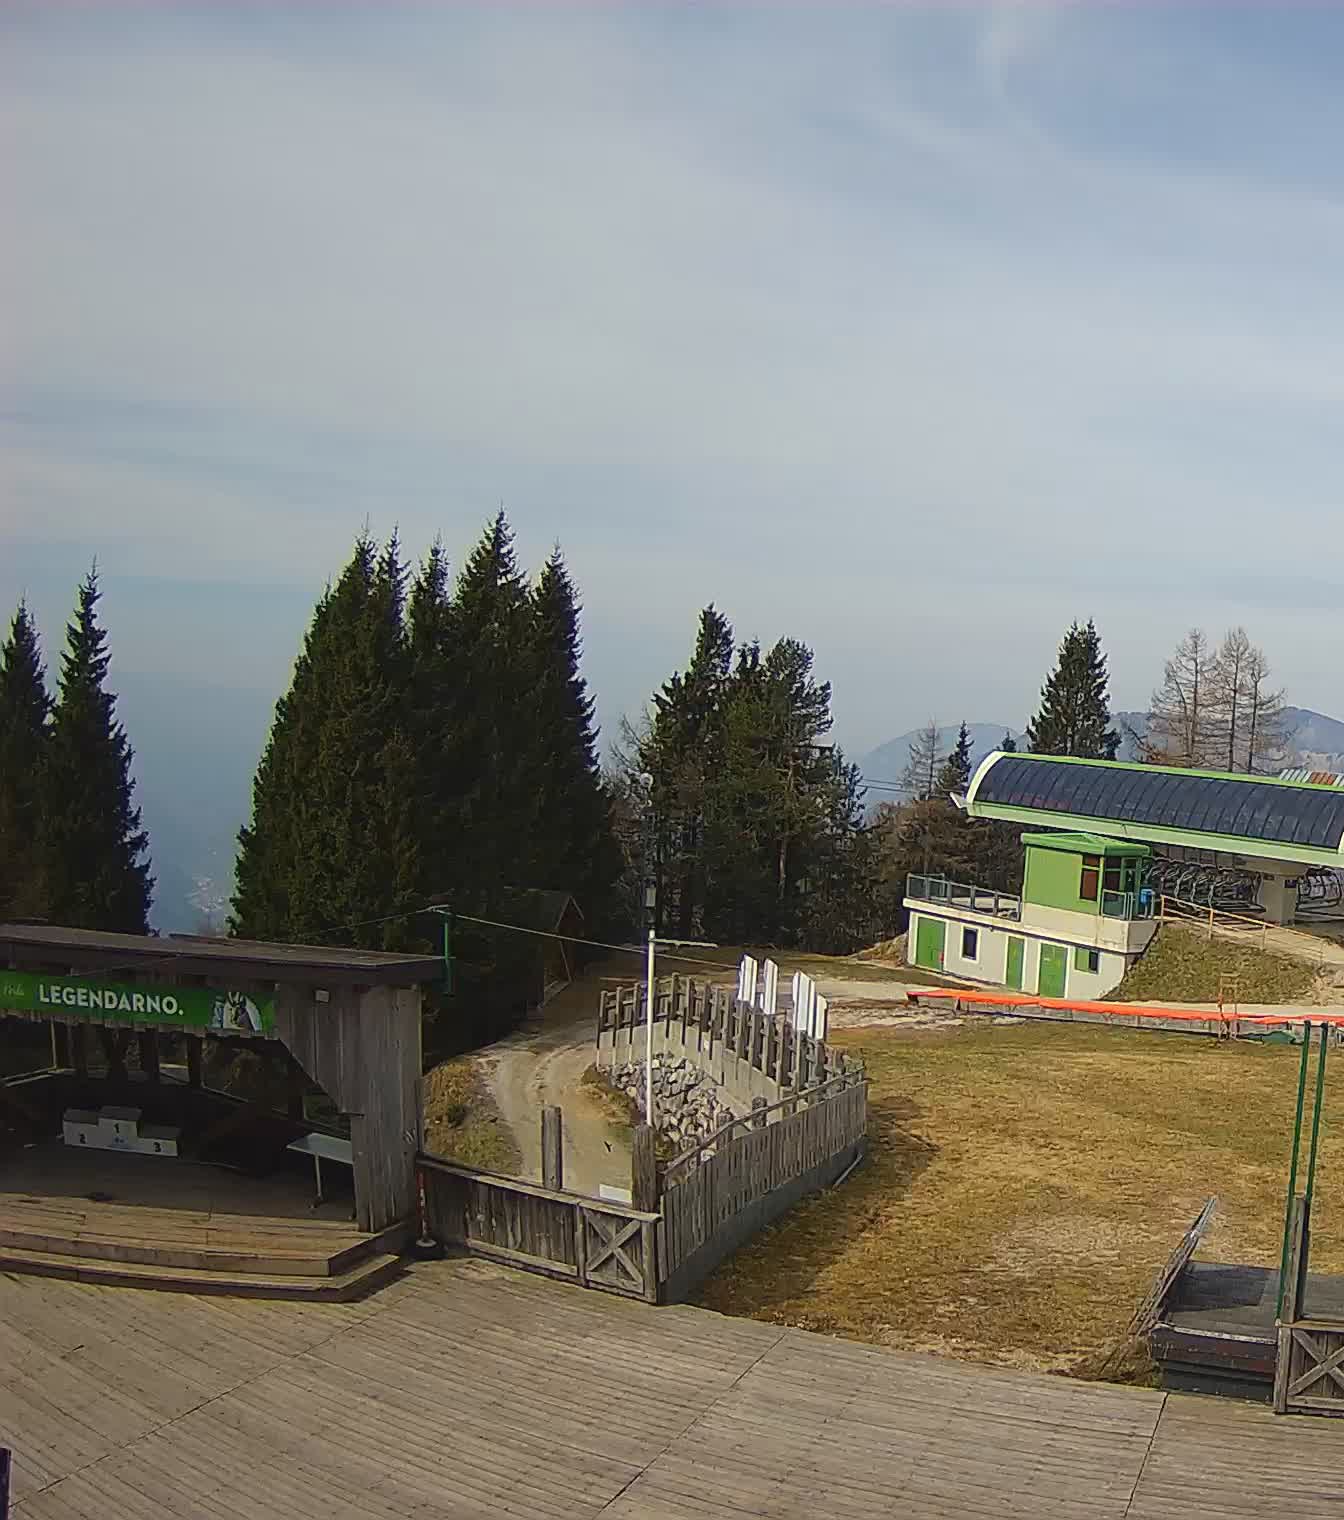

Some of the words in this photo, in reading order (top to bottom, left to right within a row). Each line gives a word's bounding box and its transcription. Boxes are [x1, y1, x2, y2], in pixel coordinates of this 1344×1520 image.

[39, 984, 184, 1016] LEGENDARNO.
[113, 1123, 120, 1134] 1
[79, 1133, 87, 1144] 2
[152, 1142, 161, 1153] 3
